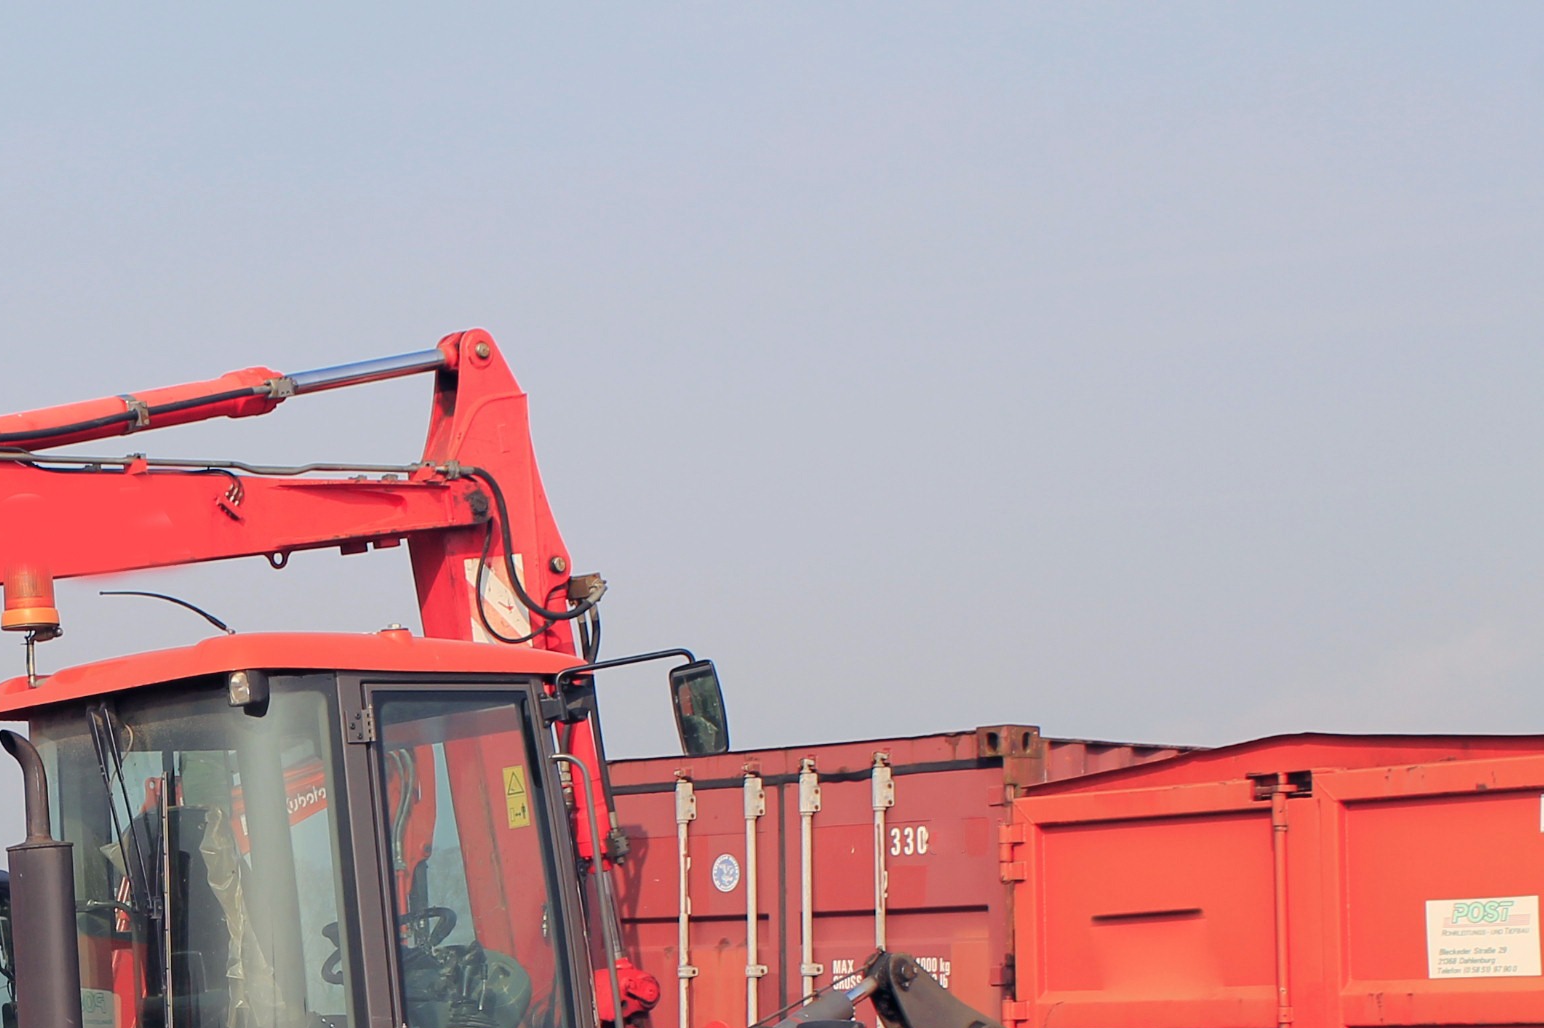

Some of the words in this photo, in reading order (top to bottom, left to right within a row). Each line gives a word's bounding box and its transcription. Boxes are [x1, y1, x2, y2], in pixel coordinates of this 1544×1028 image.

[1452, 900, 1514, 923] POST
[833, 959, 854, 974] MAX
[939, 957, 951, 976] kg
